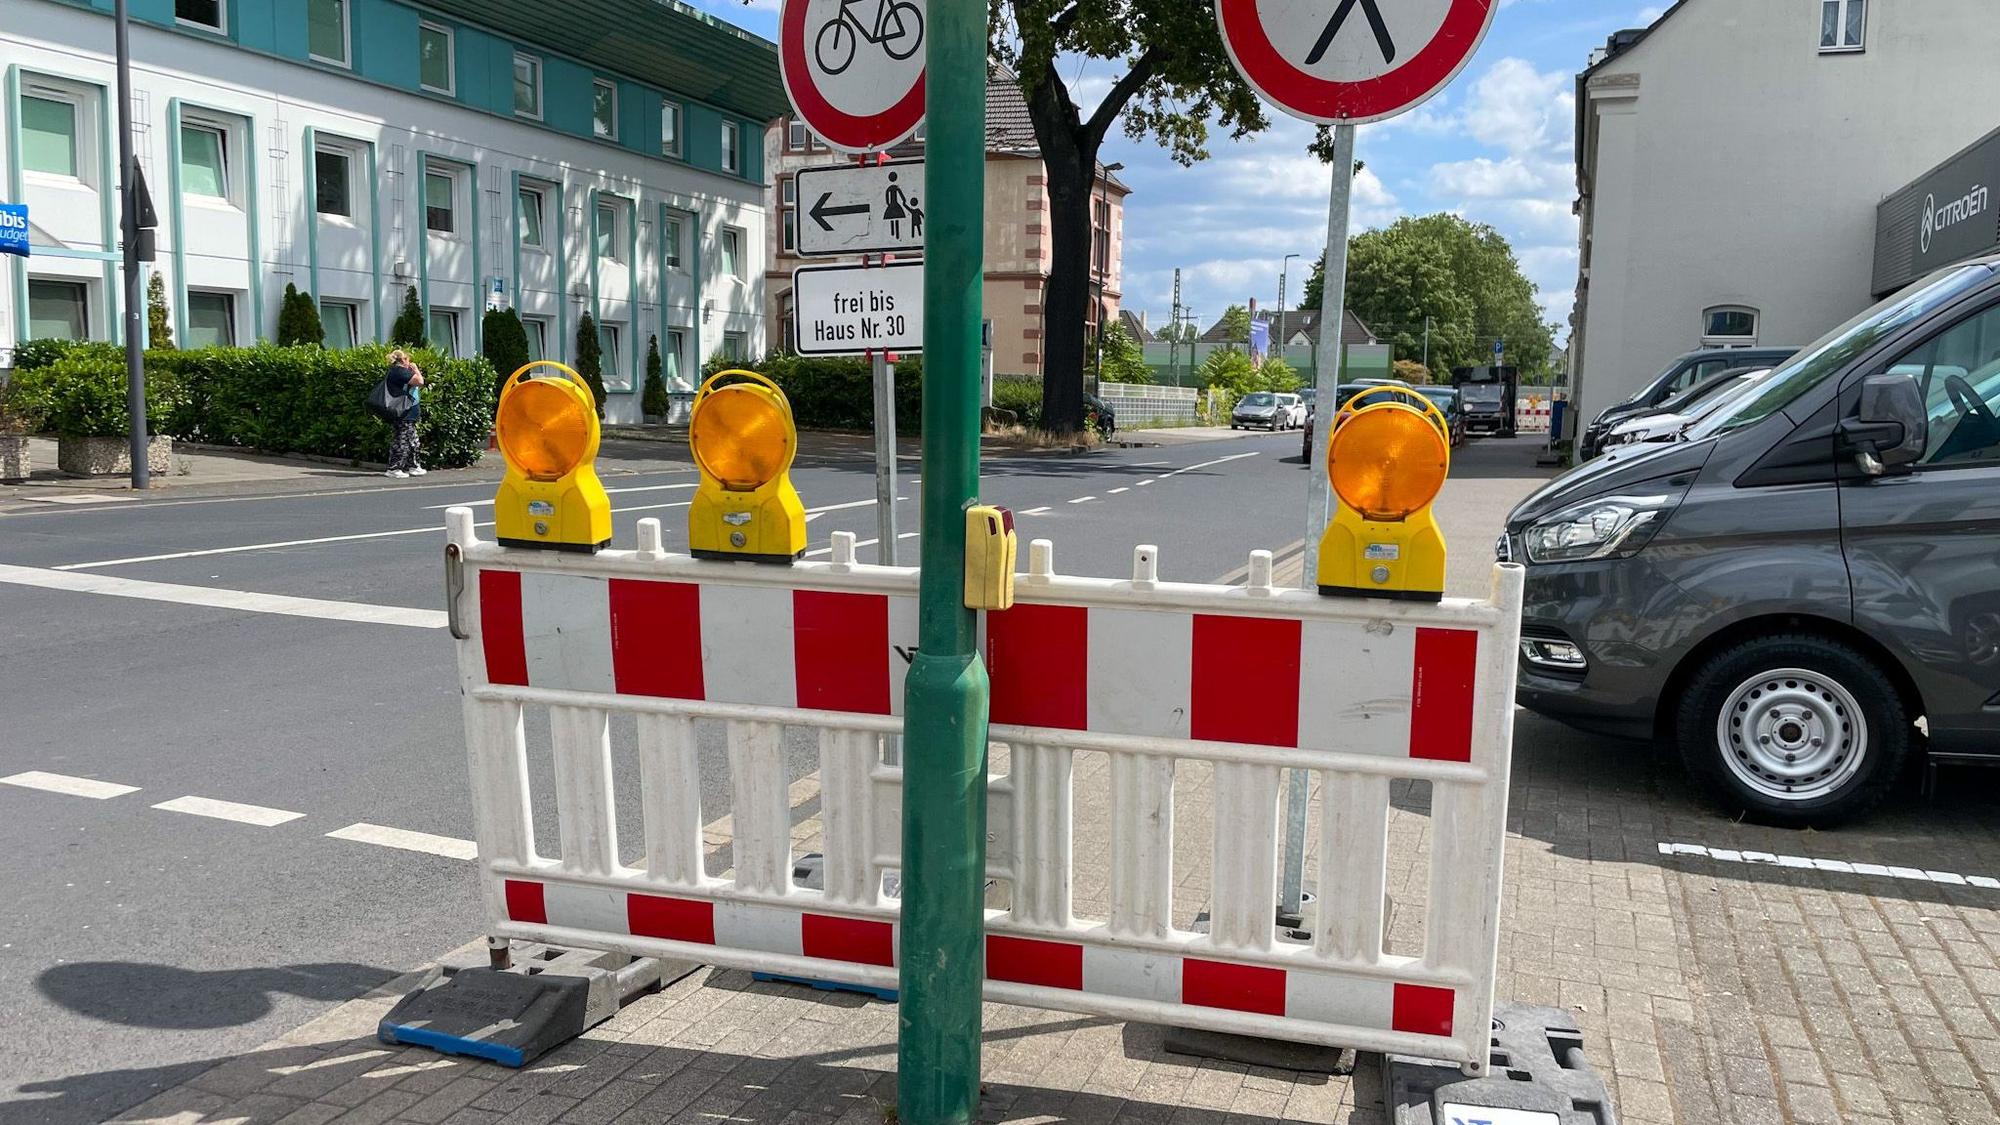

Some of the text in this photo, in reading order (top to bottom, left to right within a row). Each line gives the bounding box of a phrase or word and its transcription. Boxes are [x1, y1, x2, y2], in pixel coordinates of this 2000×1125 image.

[0, 210, 26, 229] ibis
[834, 290, 894, 314] frei bis
[815, 315, 905, 341] Haus Nr. 30
